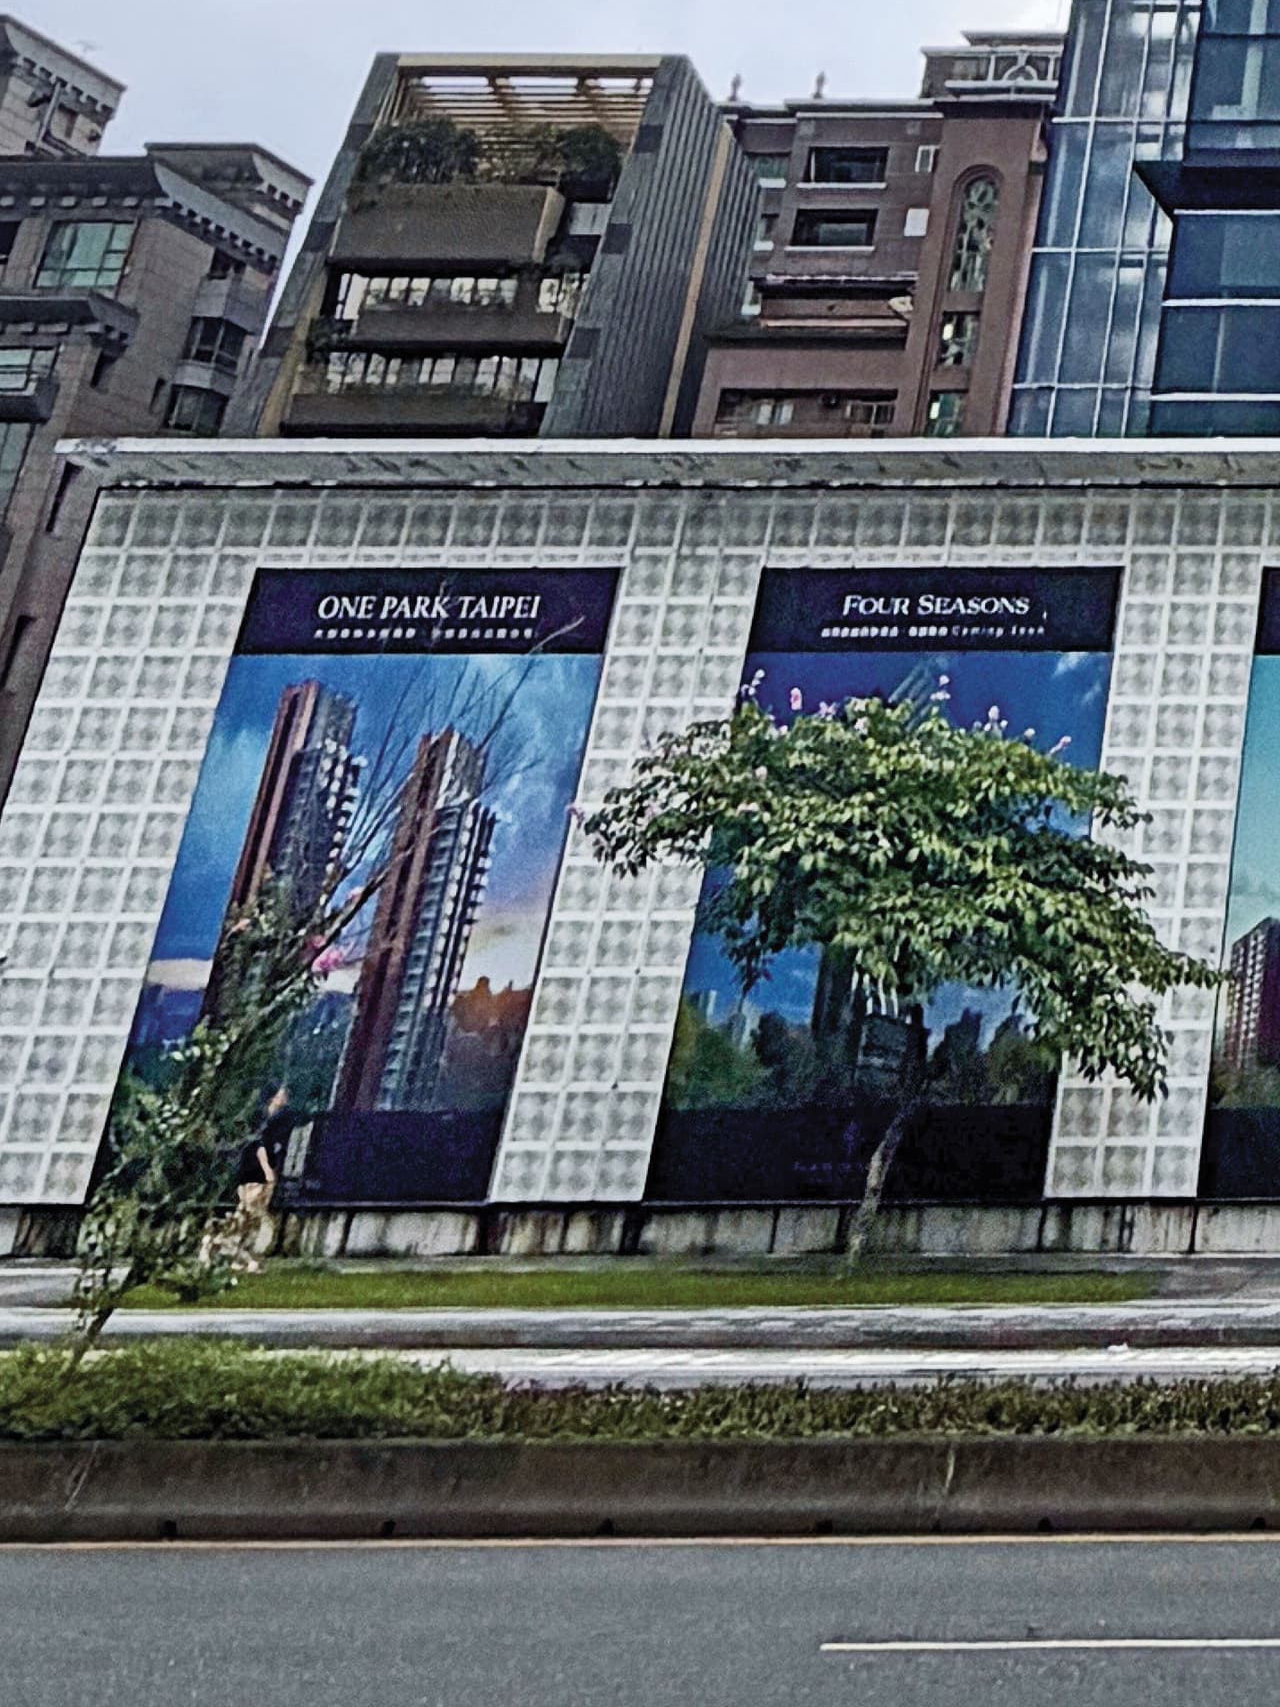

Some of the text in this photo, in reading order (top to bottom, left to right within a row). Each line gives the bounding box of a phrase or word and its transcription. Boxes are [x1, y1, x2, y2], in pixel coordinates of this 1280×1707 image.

[316, 594, 541, 620] ONE PARK TAIPEI
[842, 593, 1031, 616] FOUR SEASONS
